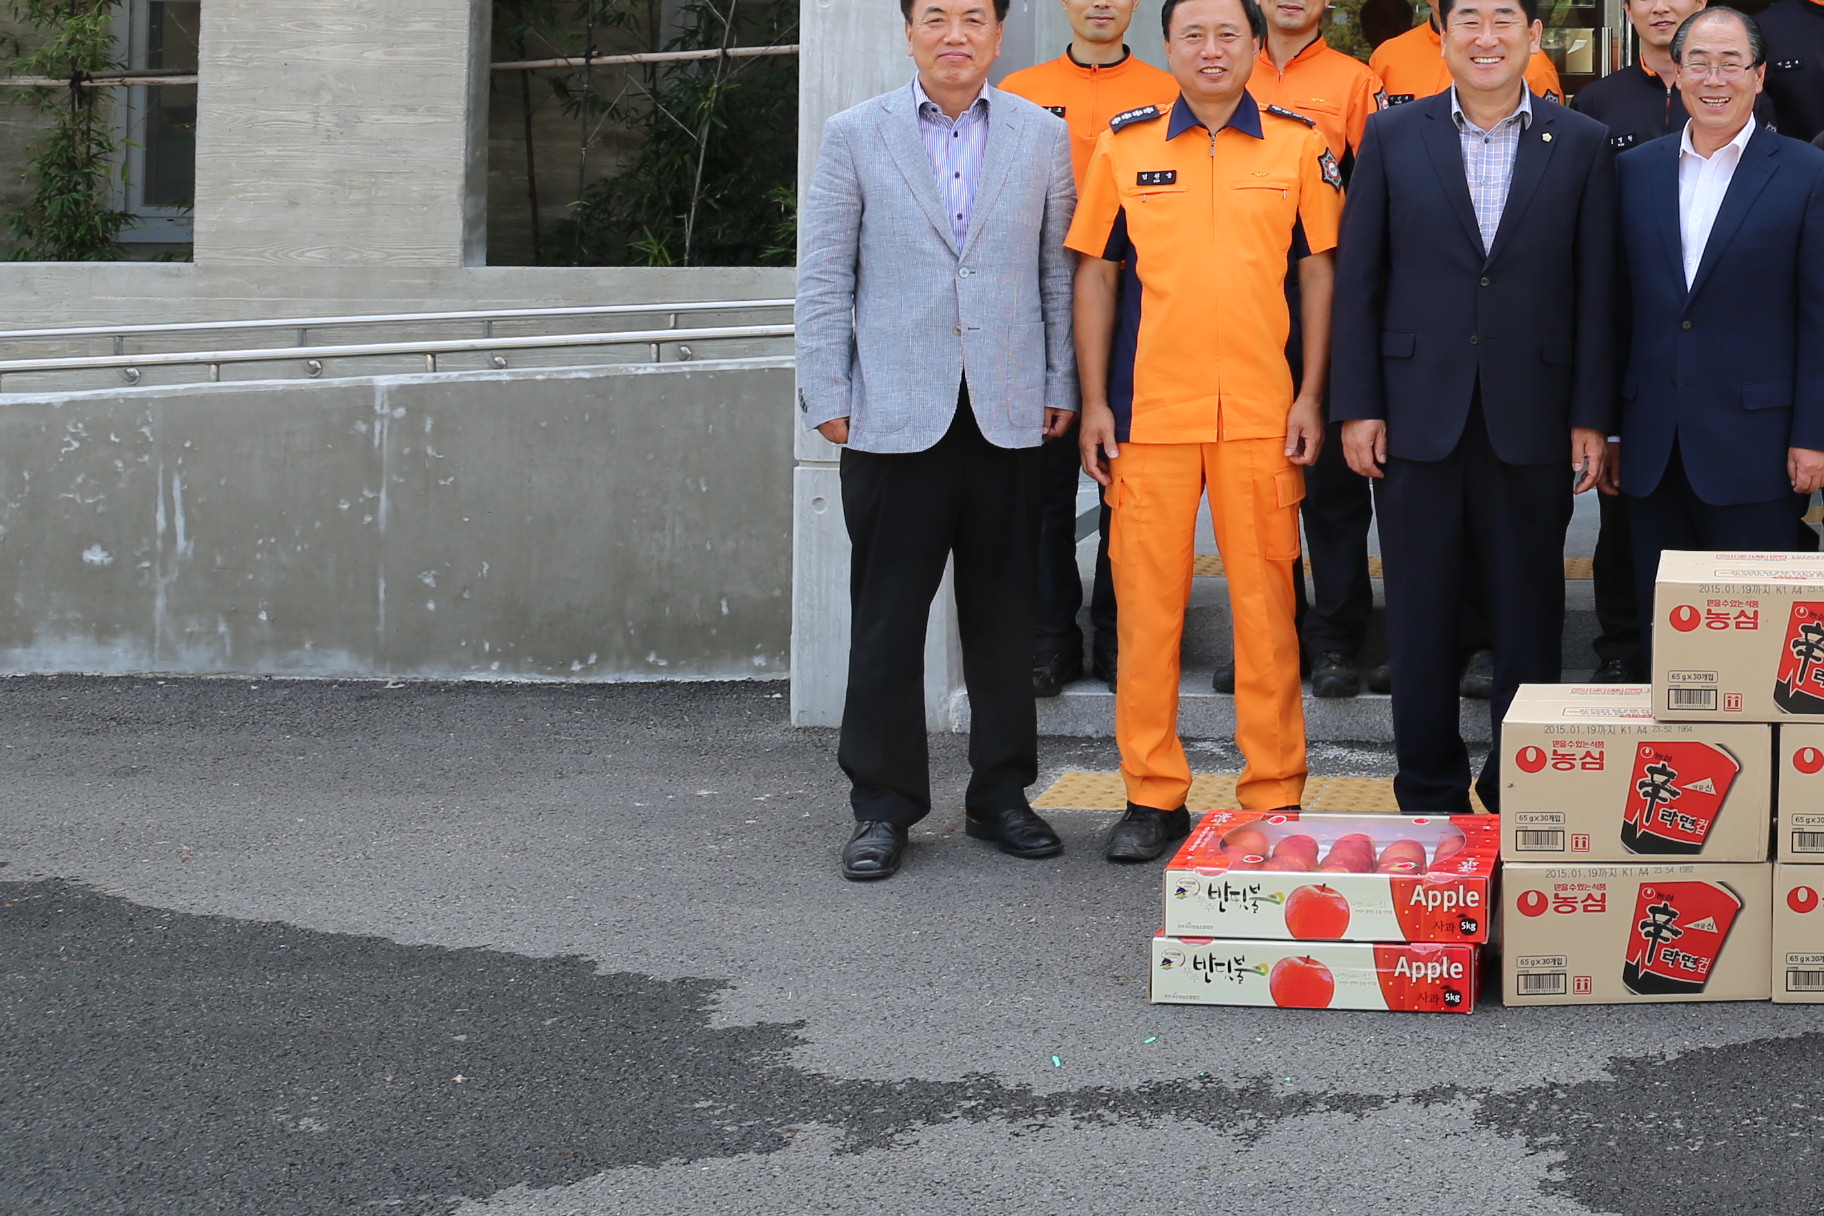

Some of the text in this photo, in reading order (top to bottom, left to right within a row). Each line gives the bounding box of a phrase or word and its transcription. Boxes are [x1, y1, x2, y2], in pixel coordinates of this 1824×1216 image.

[1776, 585, 1786, 595] K1
[1792, 585, 1802, 595] A4
[1705, 608, 1759, 630] 농심
[1621, 725, 1632, 735] K1
[1637, 725, 1647, 735] A4
[1551, 749, 1605, 771] 농심
[1637, 760, 1682, 825] 辛
[1622, 868, 1633, 878] K1
[1638, 867, 1649, 877] A4
[1409, 884, 1480, 912] Apple
[1552, 892, 1607, 914] 농심
[1433, 921, 1456, 934] 사과
[1461, 922, 1477, 932] 5kg
[1639, 901, 1684, 965] 辛
[1393, 956, 1464, 984] Apple
[1417, 992, 1440, 1005] 사과
[1445, 993, 1461, 1002] 5kg
